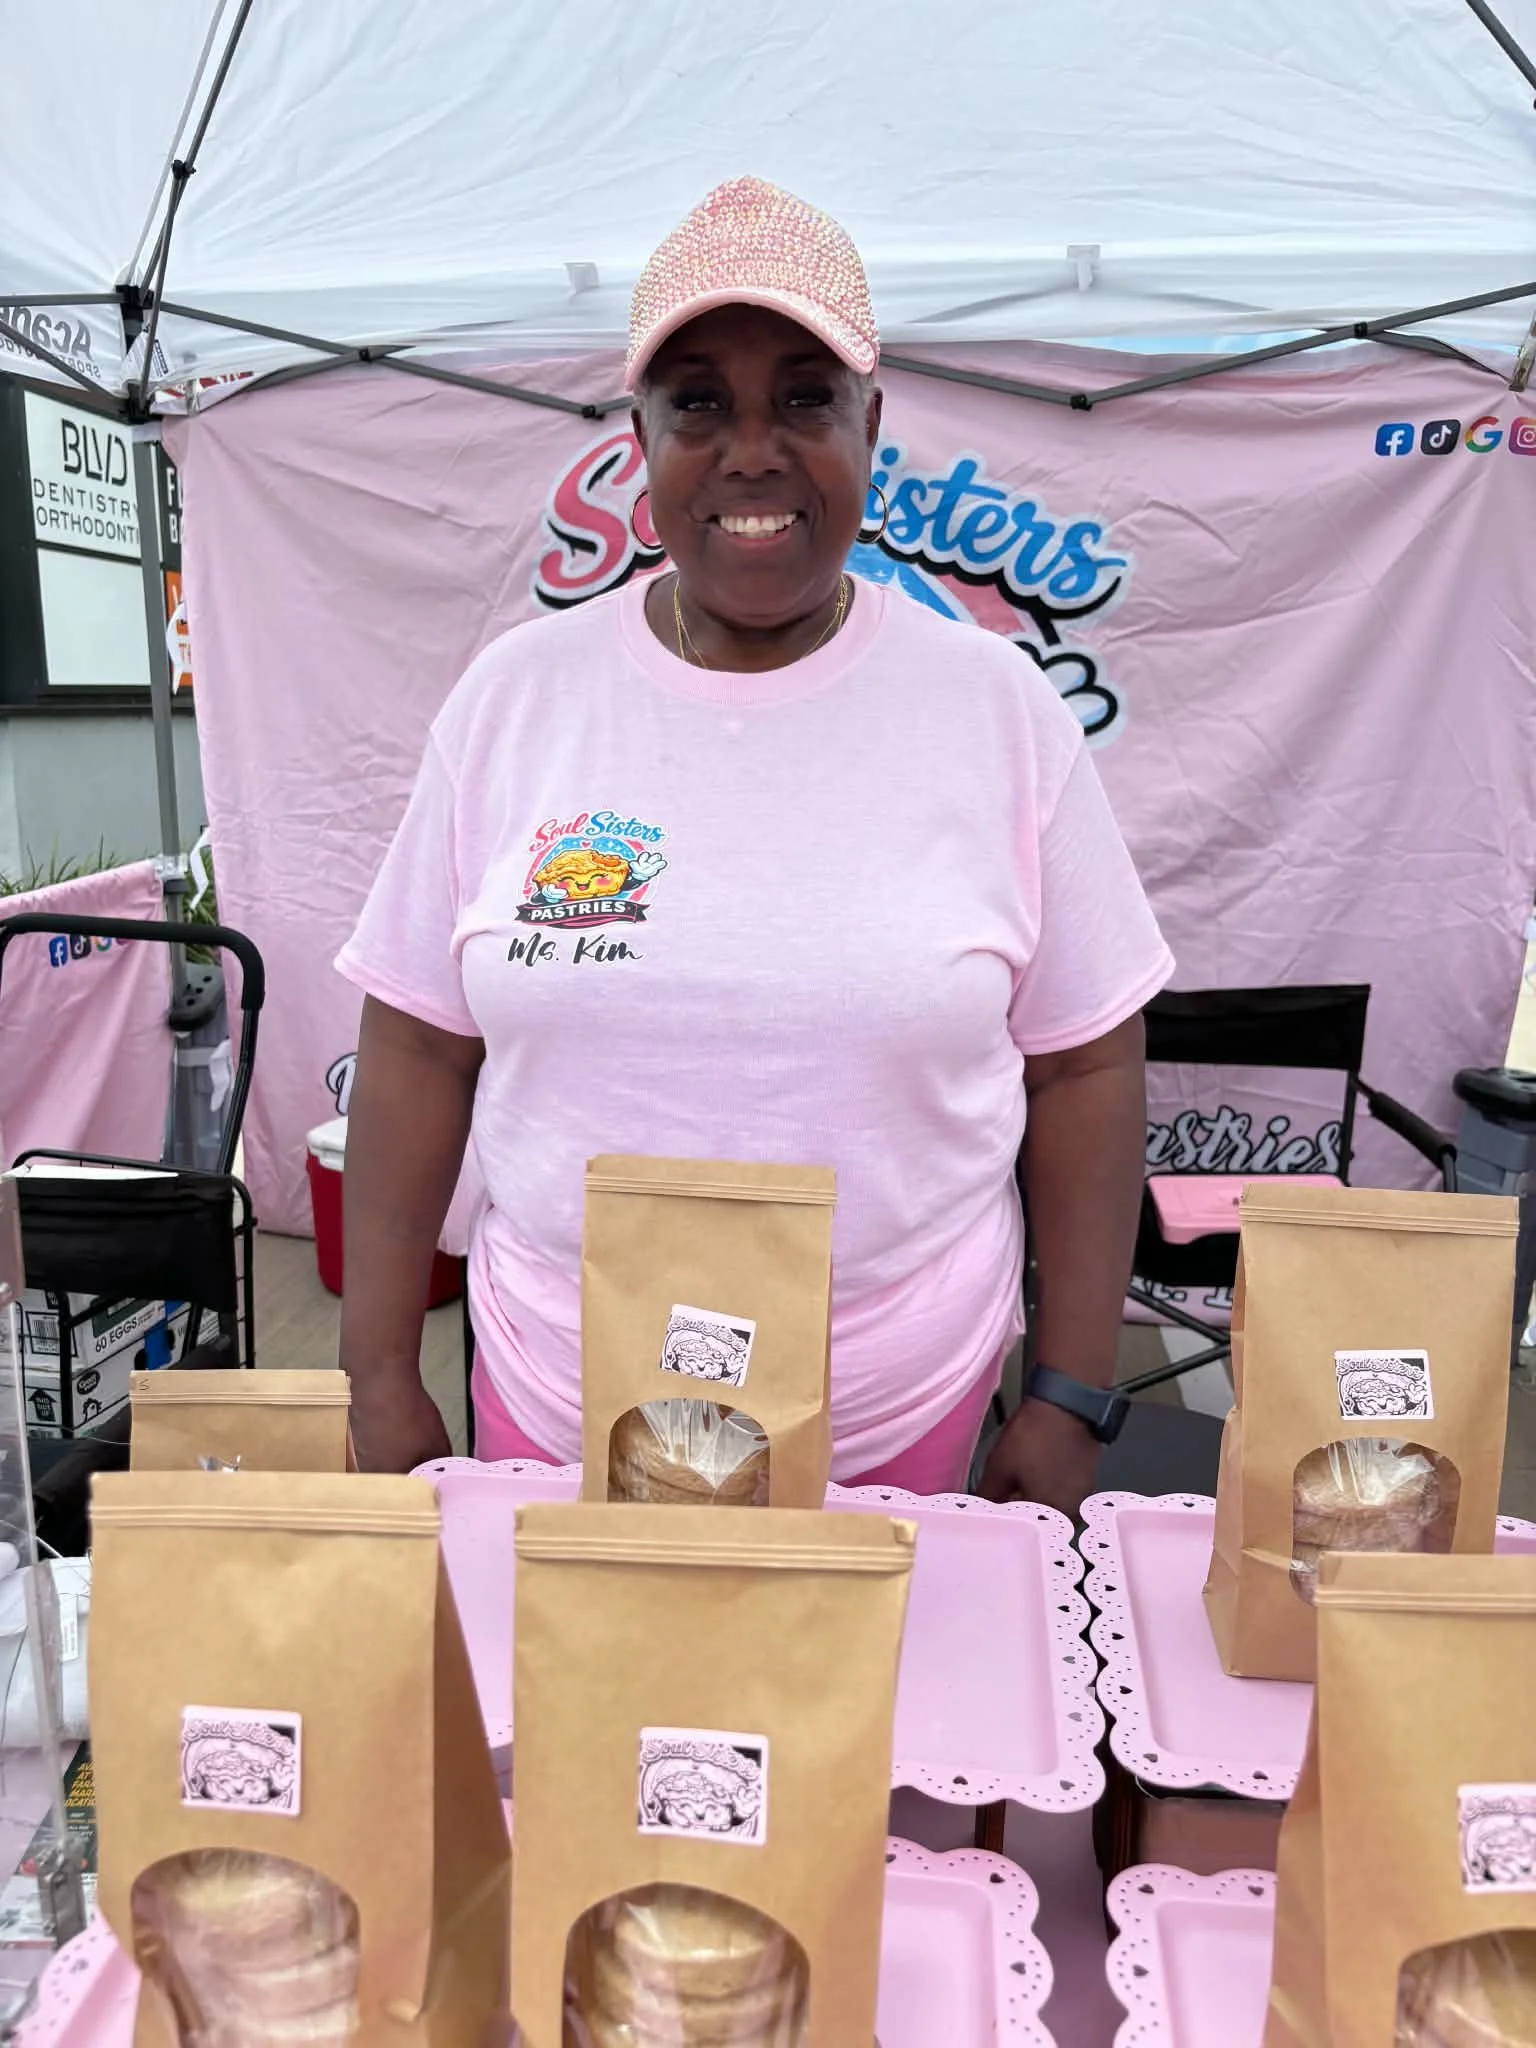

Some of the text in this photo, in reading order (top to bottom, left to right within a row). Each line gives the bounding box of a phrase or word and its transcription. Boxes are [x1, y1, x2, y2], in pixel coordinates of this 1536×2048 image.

[61, 418, 127, 486] BLVD
[36, 506, 139, 544] ORTHODONTI
[864, 446, 1127, 600] isters
[528, 811, 665, 852] Soul Sisters
[530, 900, 627, 921] PASTRIES
[507, 932, 643, 967] Ms. Kim
[1146, 1105, 1344, 1172] astries
[95, 1316, 138, 1353] 60 EGGS
